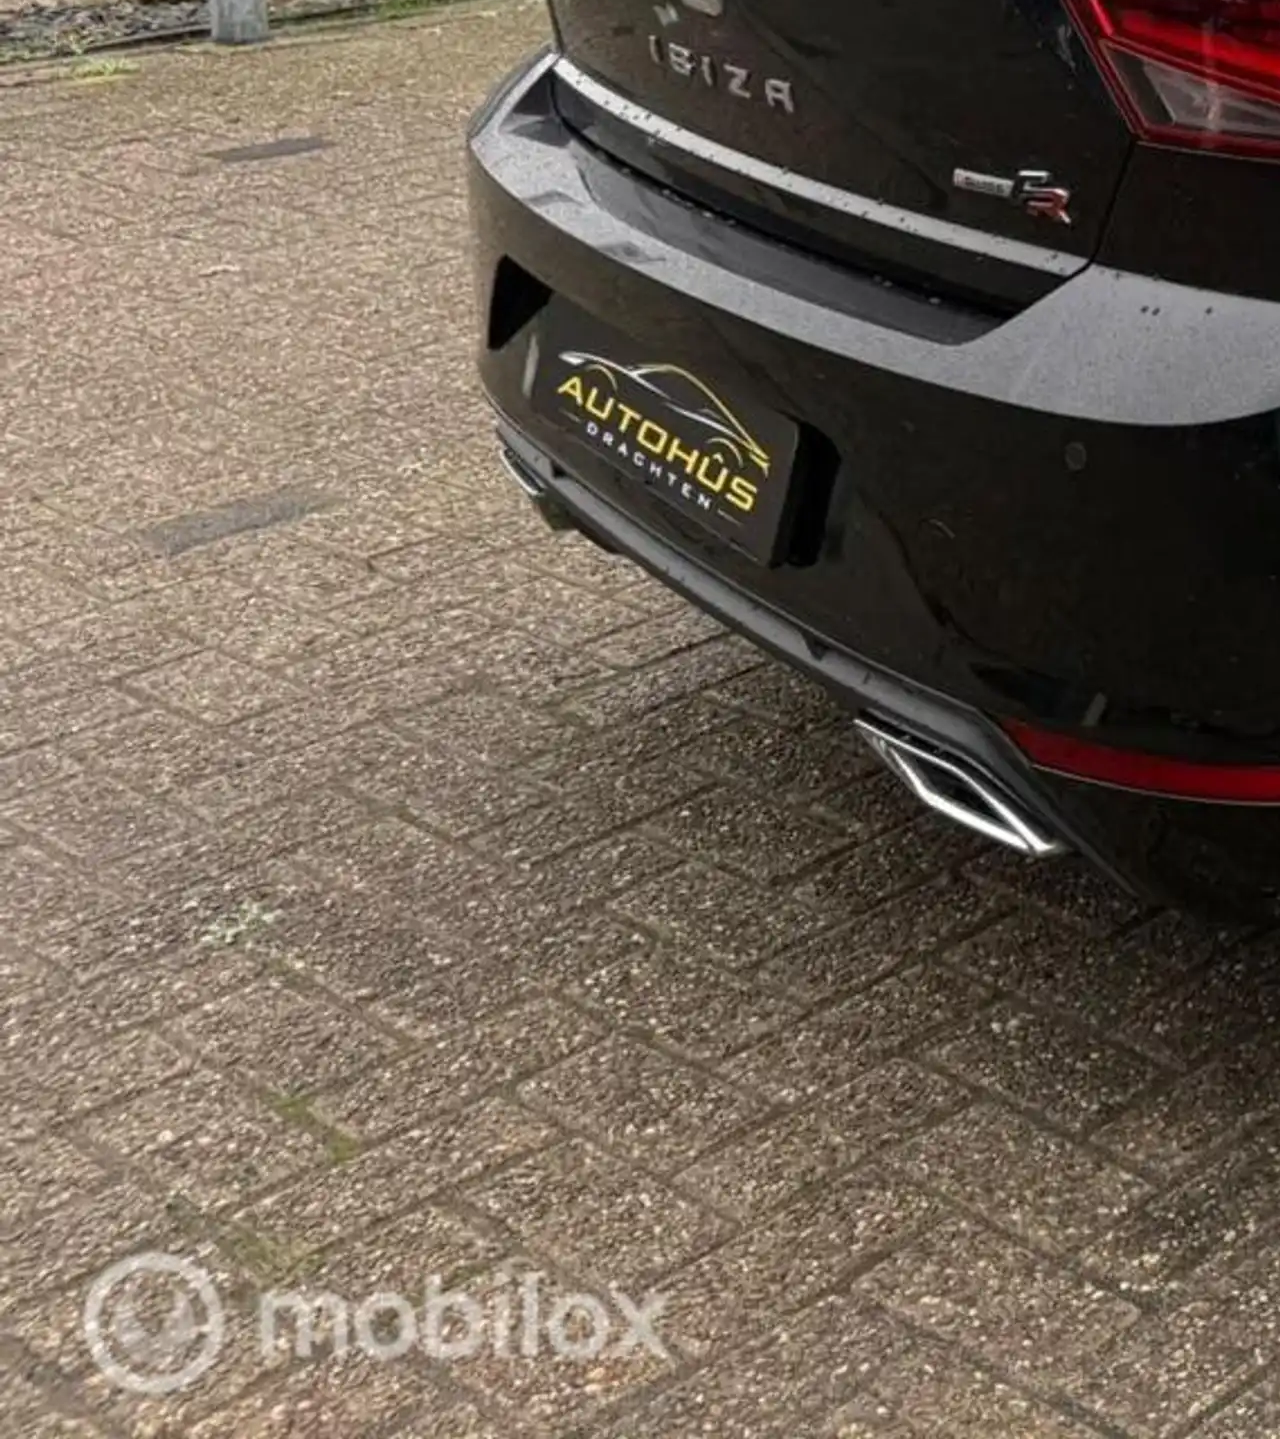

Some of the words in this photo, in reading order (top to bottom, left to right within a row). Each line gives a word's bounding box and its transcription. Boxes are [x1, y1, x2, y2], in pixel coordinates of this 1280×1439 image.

[648, 35, 794, 113] IBIZA
[557, 375, 758, 511] AUTOHÛS
[585, 421, 713, 510] DRACHTEN
